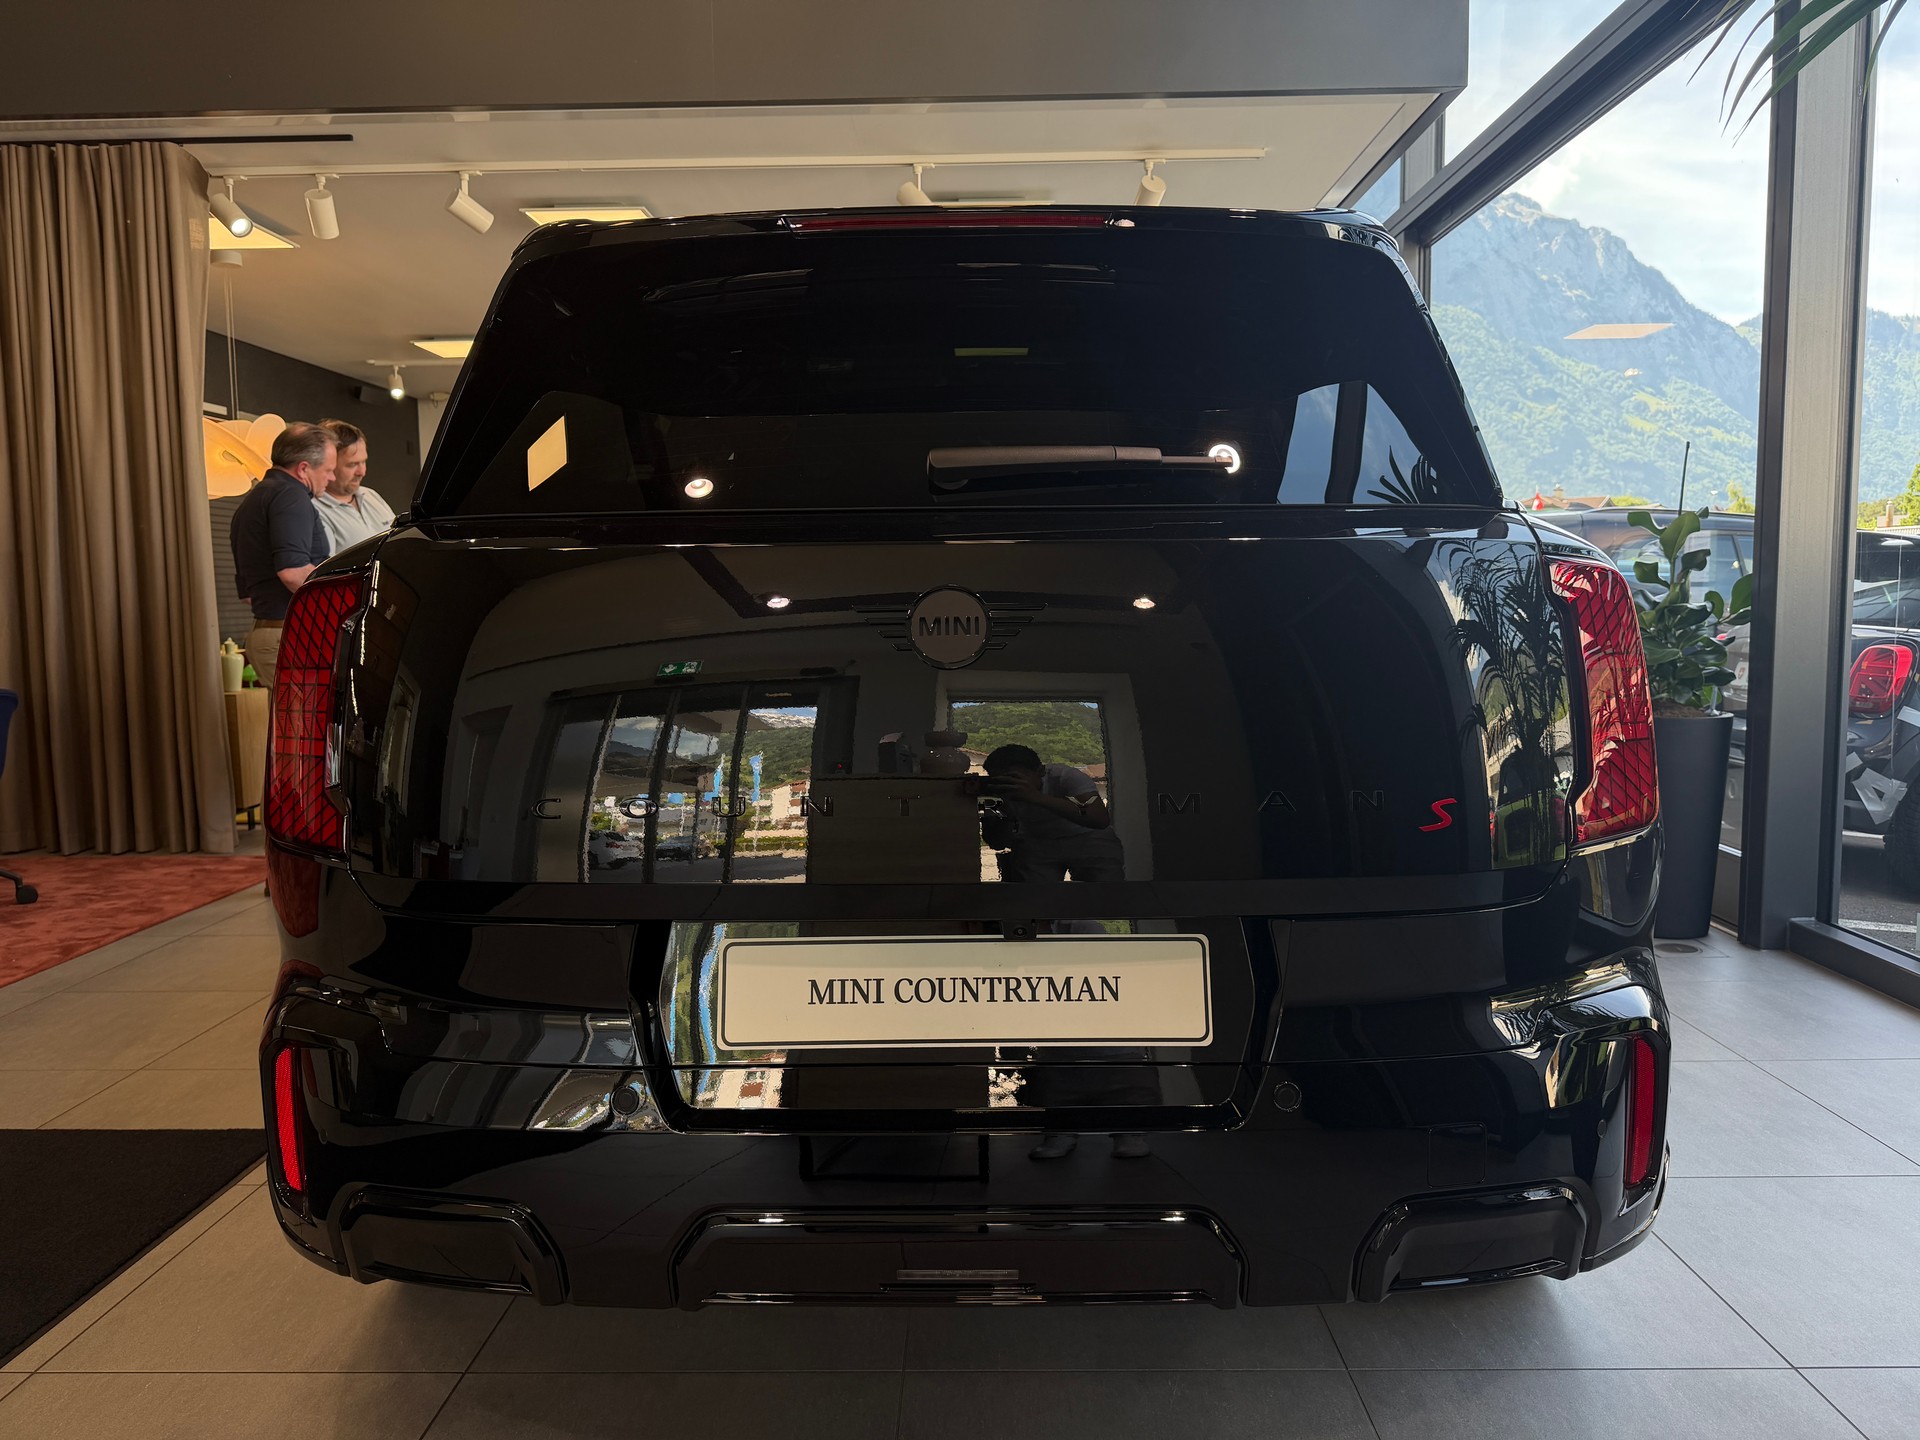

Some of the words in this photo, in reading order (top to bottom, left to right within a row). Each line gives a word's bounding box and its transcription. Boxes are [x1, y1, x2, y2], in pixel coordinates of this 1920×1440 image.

[919, 616, 980, 637] MINI
[1418, 797, 1458, 832] S
[807, 977, 885, 1005] MINI
[893, 975, 1122, 1004] COUNTRYMAN
